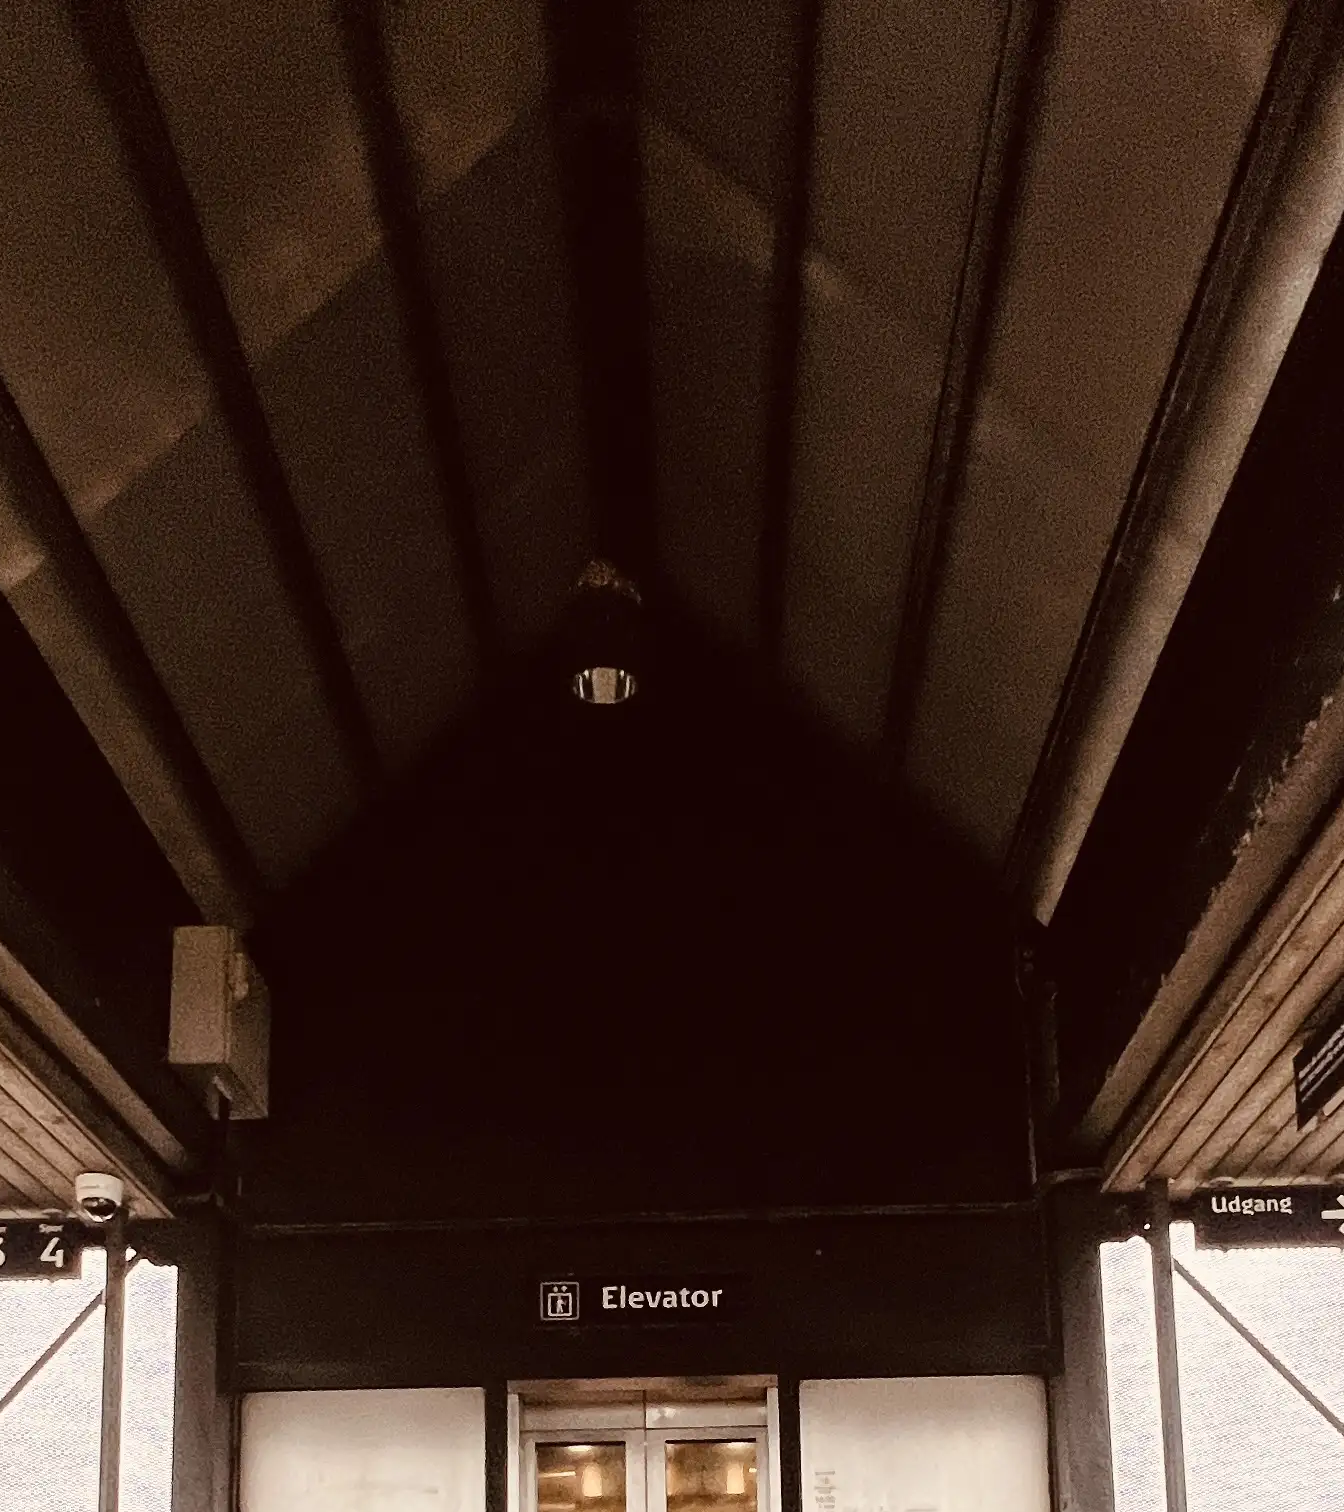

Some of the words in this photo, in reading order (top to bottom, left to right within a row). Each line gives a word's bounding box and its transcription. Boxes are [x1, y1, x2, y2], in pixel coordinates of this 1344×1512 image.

[1211, 1195, 1293, 1216] Udgang
[39, 1236, 64, 1268] 4
[602, 1285, 723, 1309] Elevator
